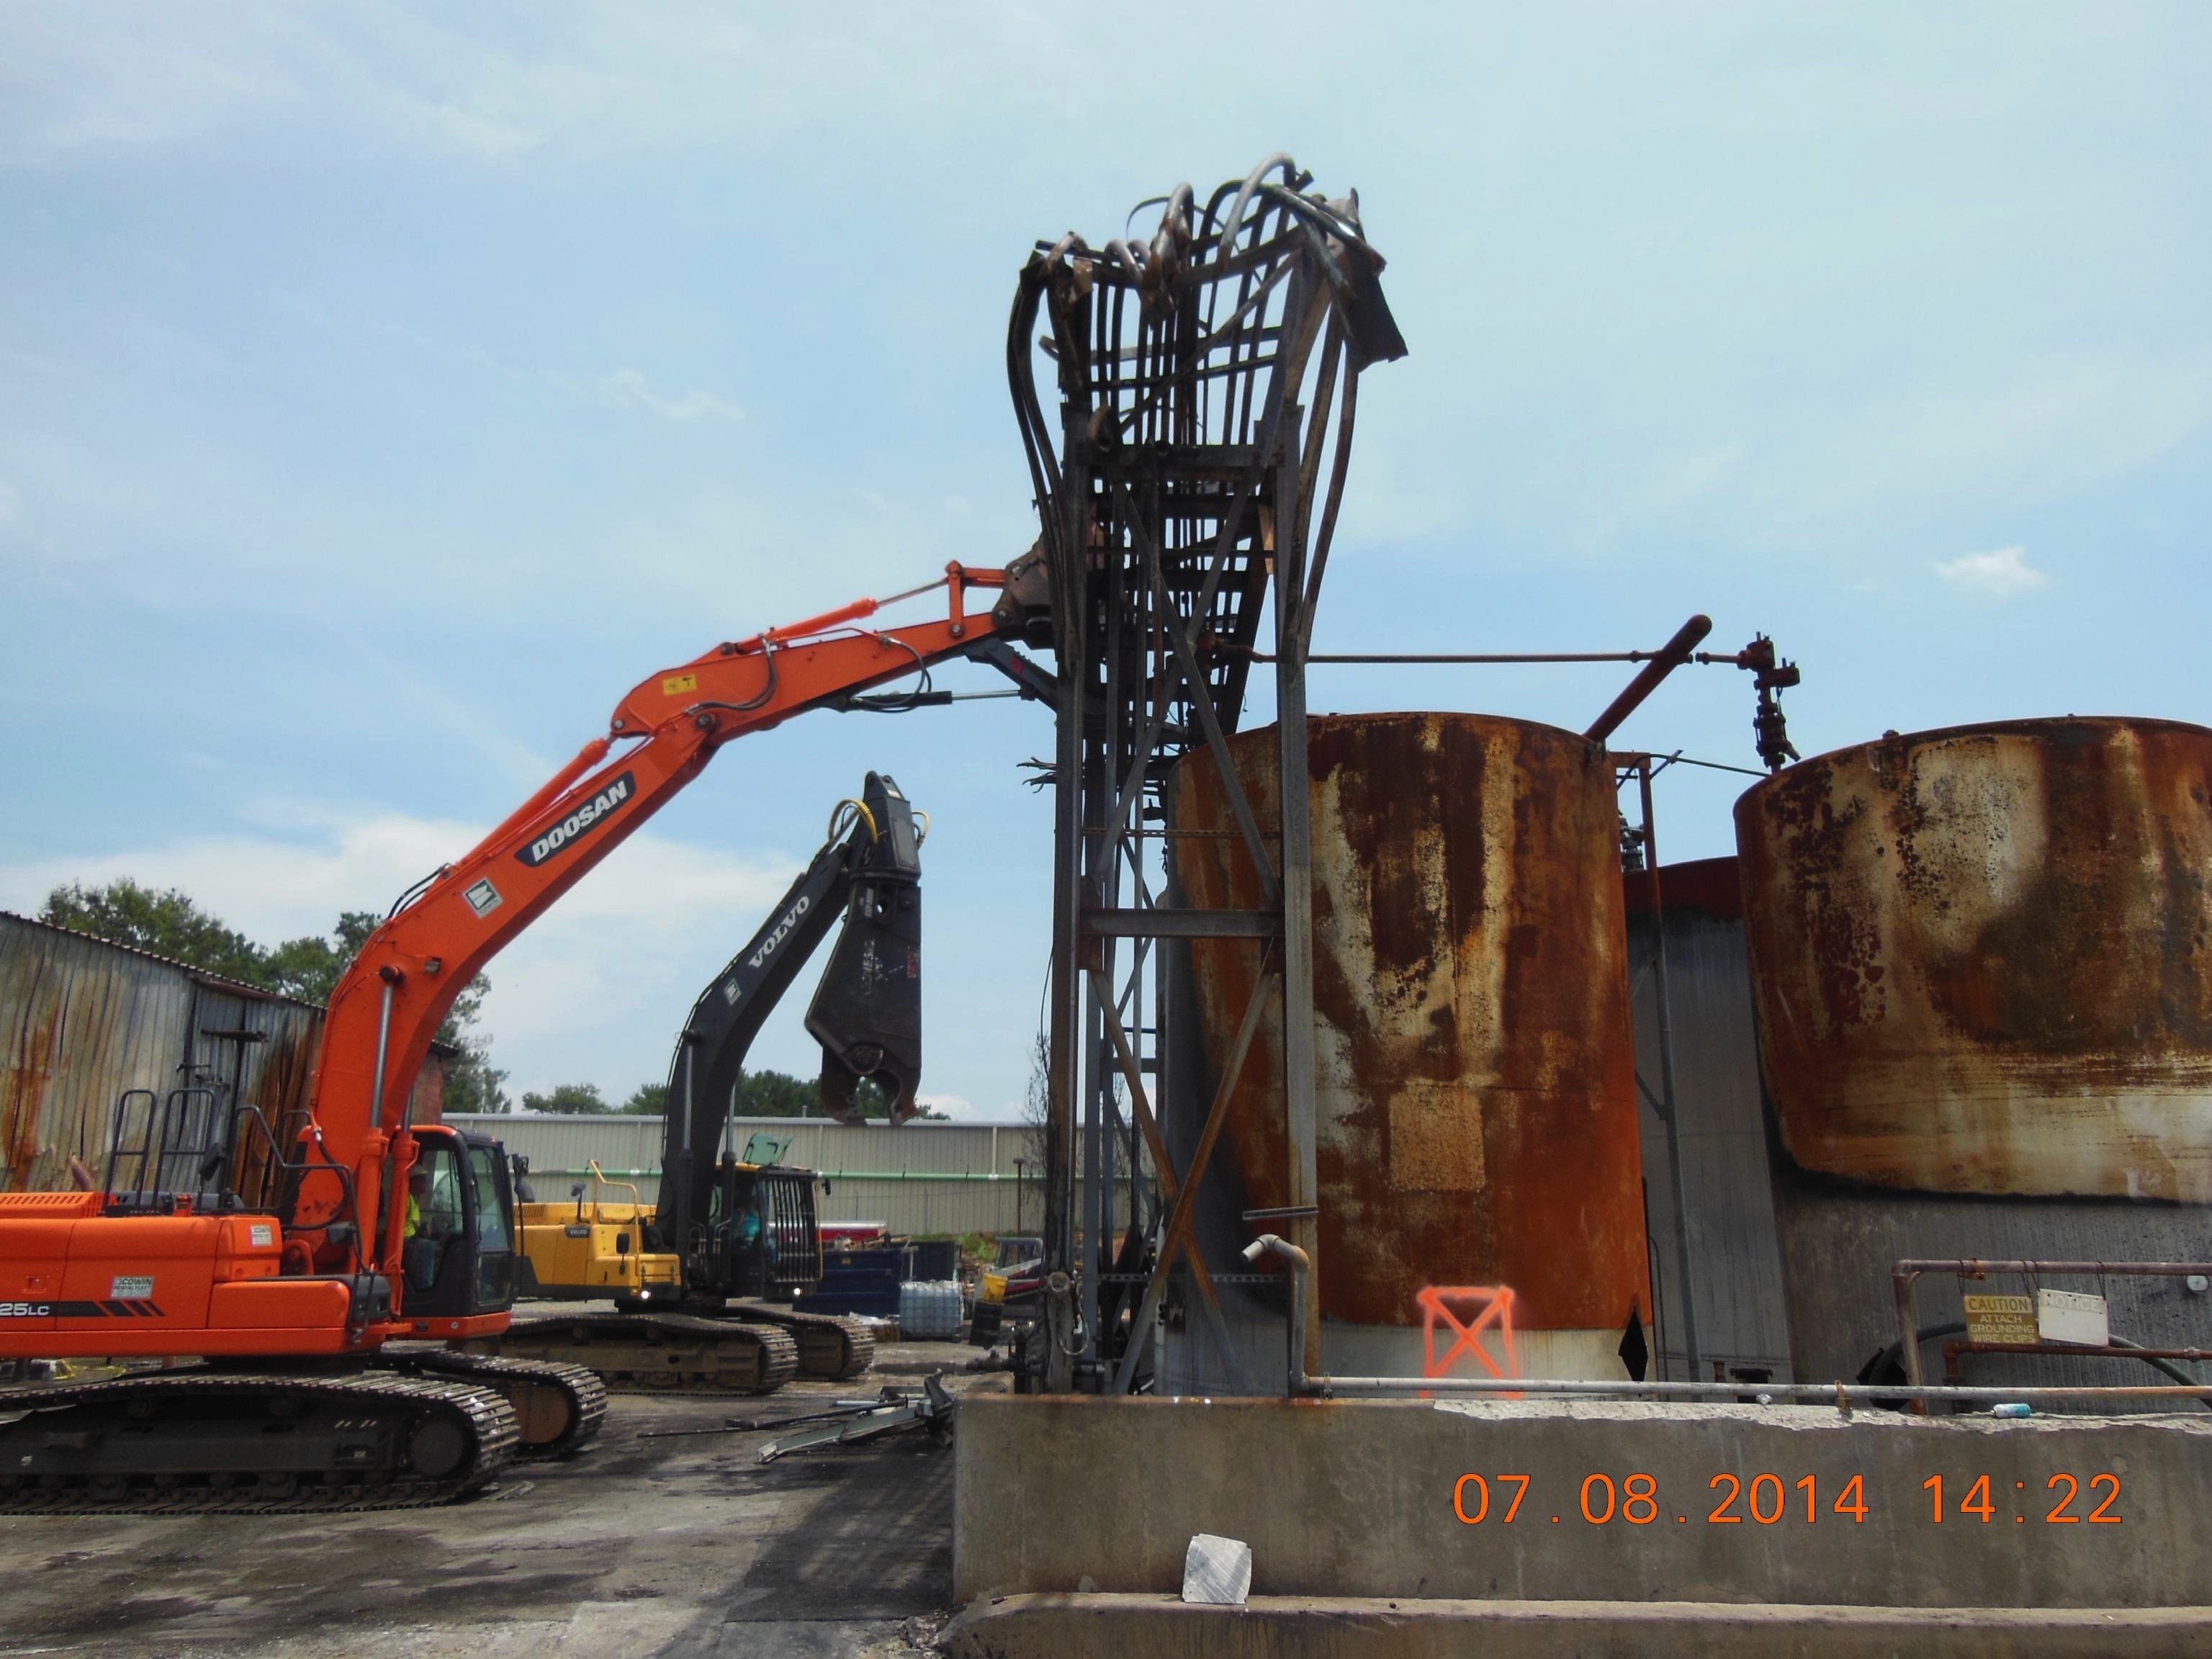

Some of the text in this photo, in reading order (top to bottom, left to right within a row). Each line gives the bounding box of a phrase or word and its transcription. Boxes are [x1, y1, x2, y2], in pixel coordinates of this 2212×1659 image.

[532, 781, 628, 862] DOOSAN
[749, 896, 809, 967] VOLVO
[1969, 1298, 2028, 1311] CAUTION
[2044, 1295, 2099, 1310] NOTICE
[0, 1303, 50, 1316] 25LC
[1980, 1315, 2022, 1323] ATTACH
[1970, 1324, 2035, 1334] GROUNDING
[1974, 1334, 2036, 1344] WIRE CLIPS
